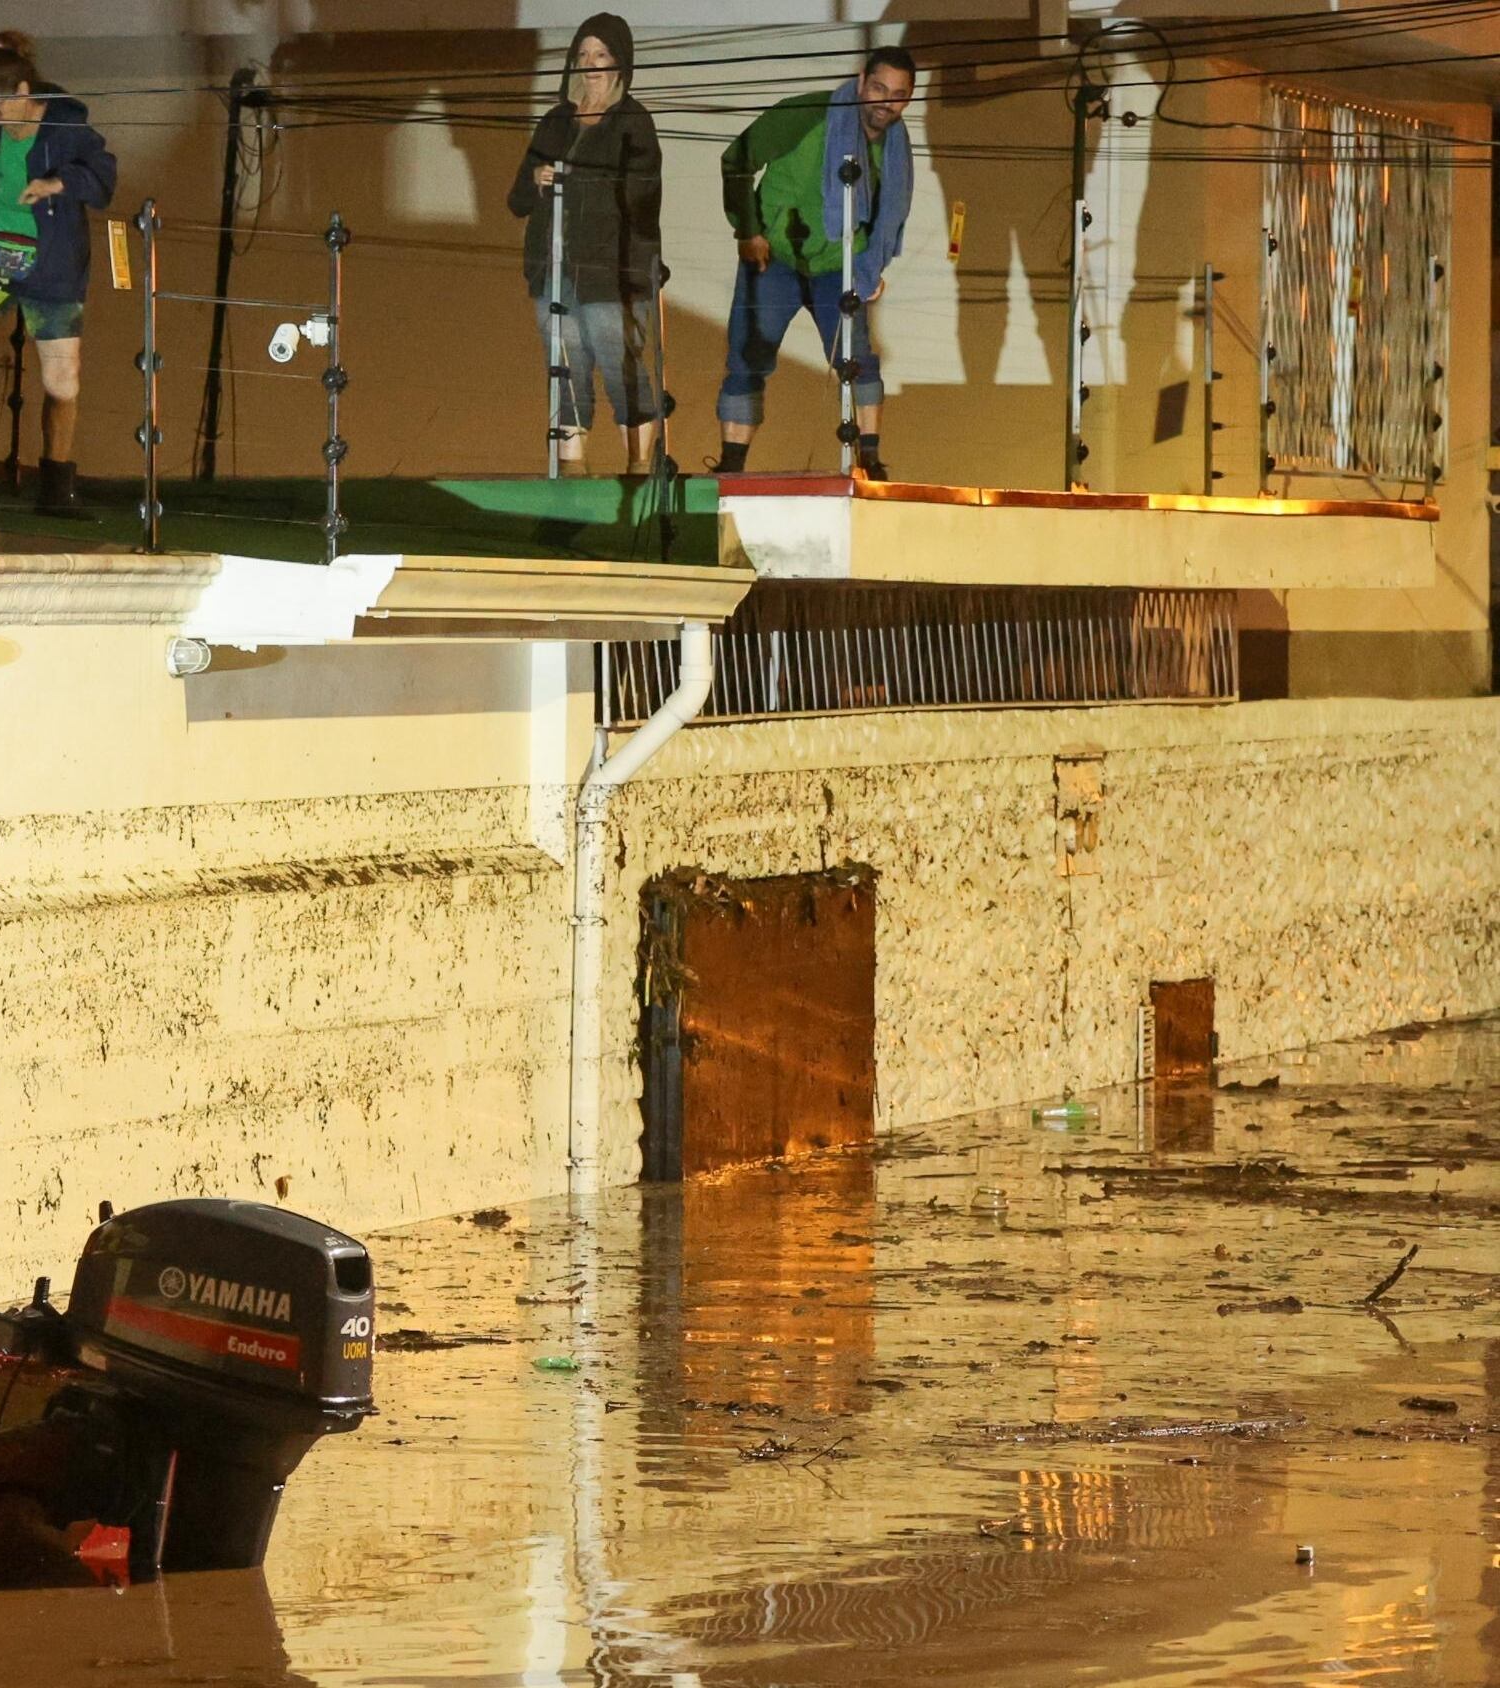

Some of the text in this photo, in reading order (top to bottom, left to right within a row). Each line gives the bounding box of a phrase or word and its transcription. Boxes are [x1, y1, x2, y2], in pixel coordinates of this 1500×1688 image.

[188, 1273, 292, 1322] YAMAHA
[340, 1316, 370, 1338] 40
[227, 1335, 287, 1362] Enduro
